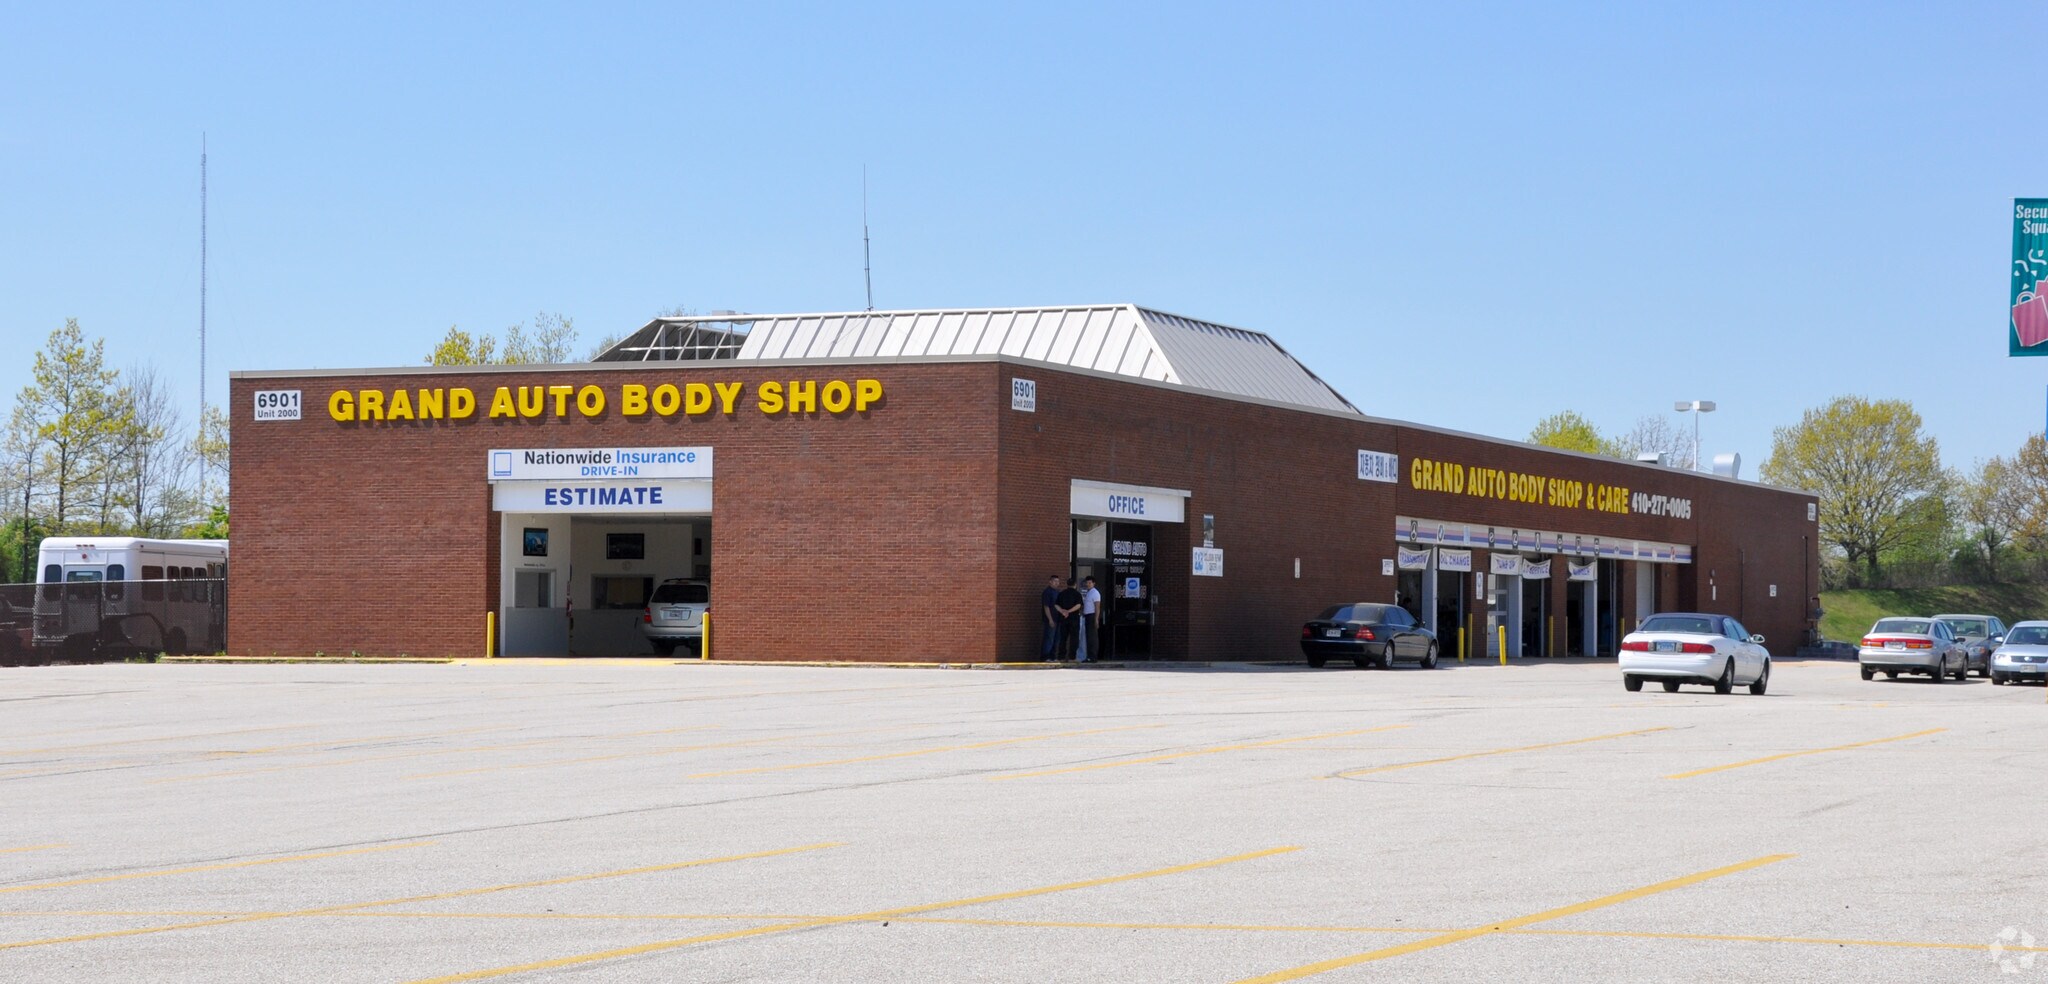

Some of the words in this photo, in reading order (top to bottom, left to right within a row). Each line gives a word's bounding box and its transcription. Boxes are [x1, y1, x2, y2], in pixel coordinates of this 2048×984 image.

[2016, 204, 2048, 219] Secu
[2023, 219, 2048, 236] Squ
[1014, 380, 1034, 398] 6901
[258, 392, 298, 408] 6901
[328, 387, 477, 421] GRAND
[489, 384, 606, 419] AUTO
[621, 382, 743, 416] BODY
[758, 379, 883, 414] SHOP
[1013, 398, 1022, 407] Unit
[1023, 400, 1034, 409] 2000
[257, 409, 275, 418] Unit
[278, 409, 298, 417] 2000
[524, 450, 611, 465] Nationwide
[616, 450, 696, 464] Insurance
[581, 466, 638, 476] DRIVE-IN
[1411, 457, 1464, 494] GRAND
[1467, 466, 1505, 500] AUTO
[1509, 472, 1546, 504] BODY
[1548, 477, 1583, 509] SHOP
[1586, 482, 1595, 510] &
[1597, 484, 1629, 514] CARE
[544, 486, 663, 506] ESTIMATE
[1108, 494, 1145, 515] OFFICE
[1631, 492, 1692, 519] 410-277-0005
[1112, 540, 1132, 555] GRAND
[1132, 541, 1147, 556] AUTO
[1449, 554, 1470, 566] CHANGE
